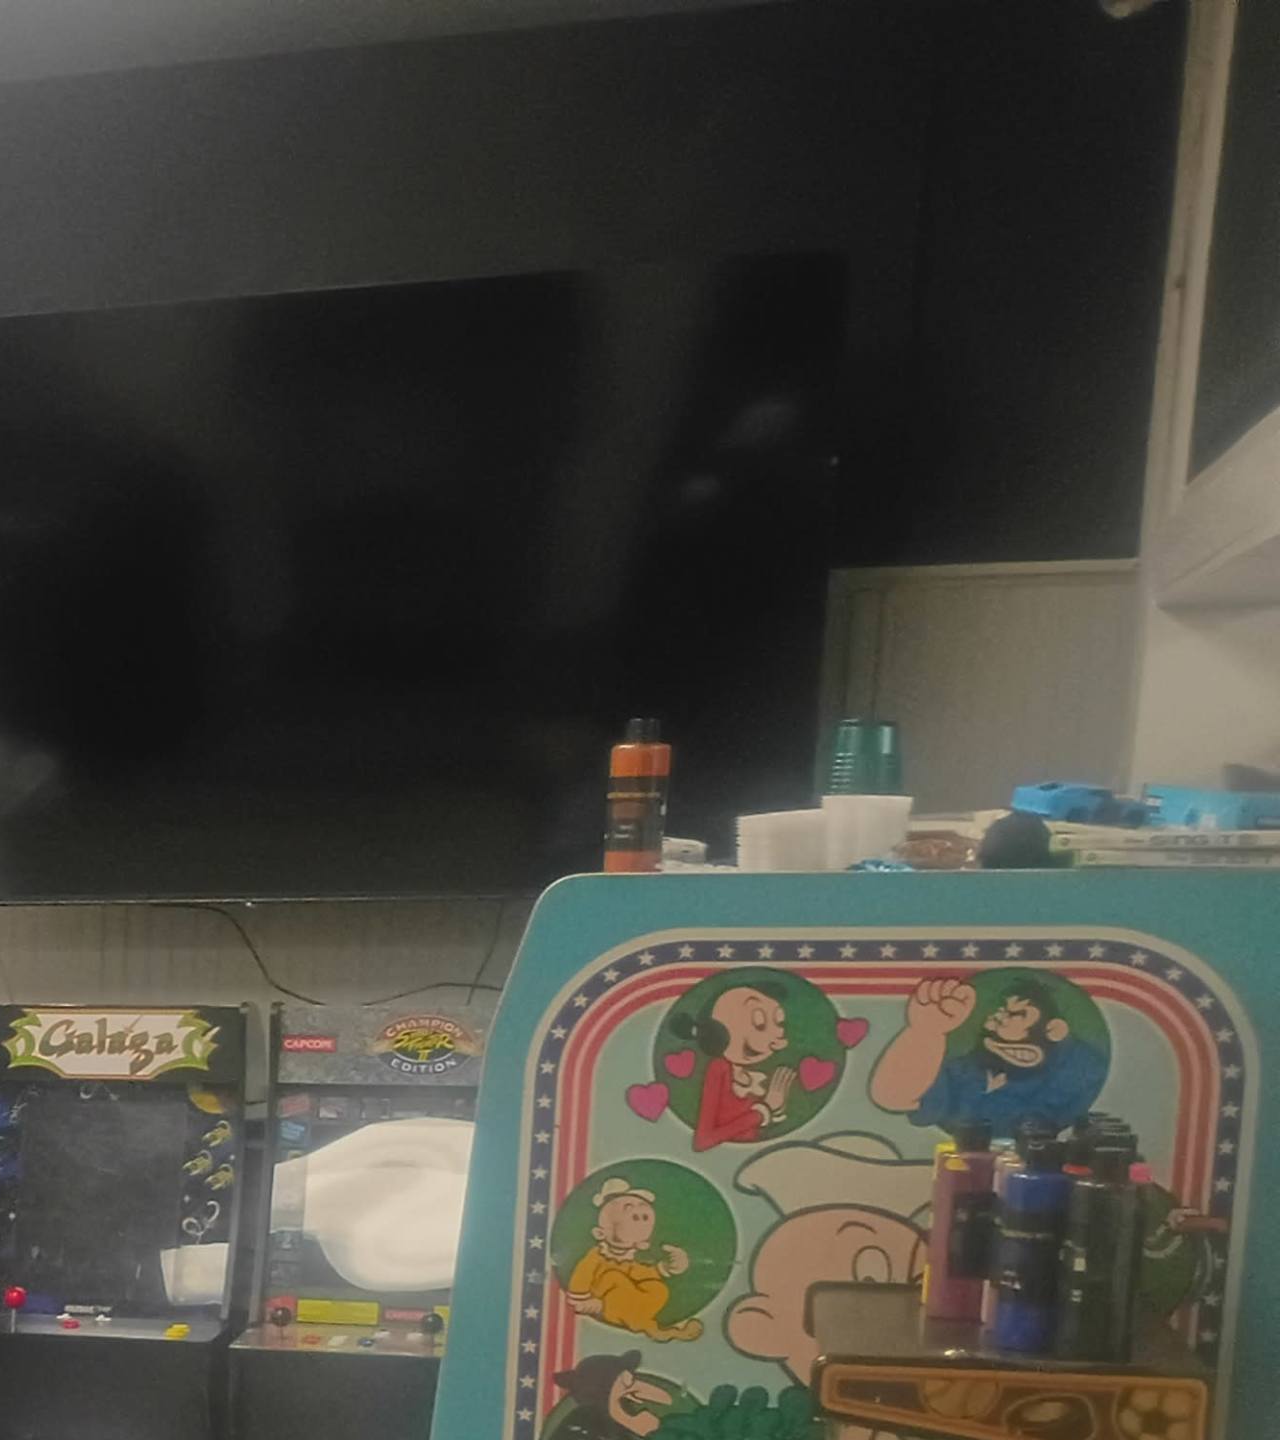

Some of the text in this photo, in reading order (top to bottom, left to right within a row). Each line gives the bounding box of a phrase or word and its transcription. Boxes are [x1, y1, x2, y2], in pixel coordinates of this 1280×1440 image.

[385, 1018, 464, 1038] CHAMPION
[39, 1017, 179, 1077] Galaga
[283, 1038, 333, 1050] CAPCOM
[390, 1057, 458, 1074] EDITION
